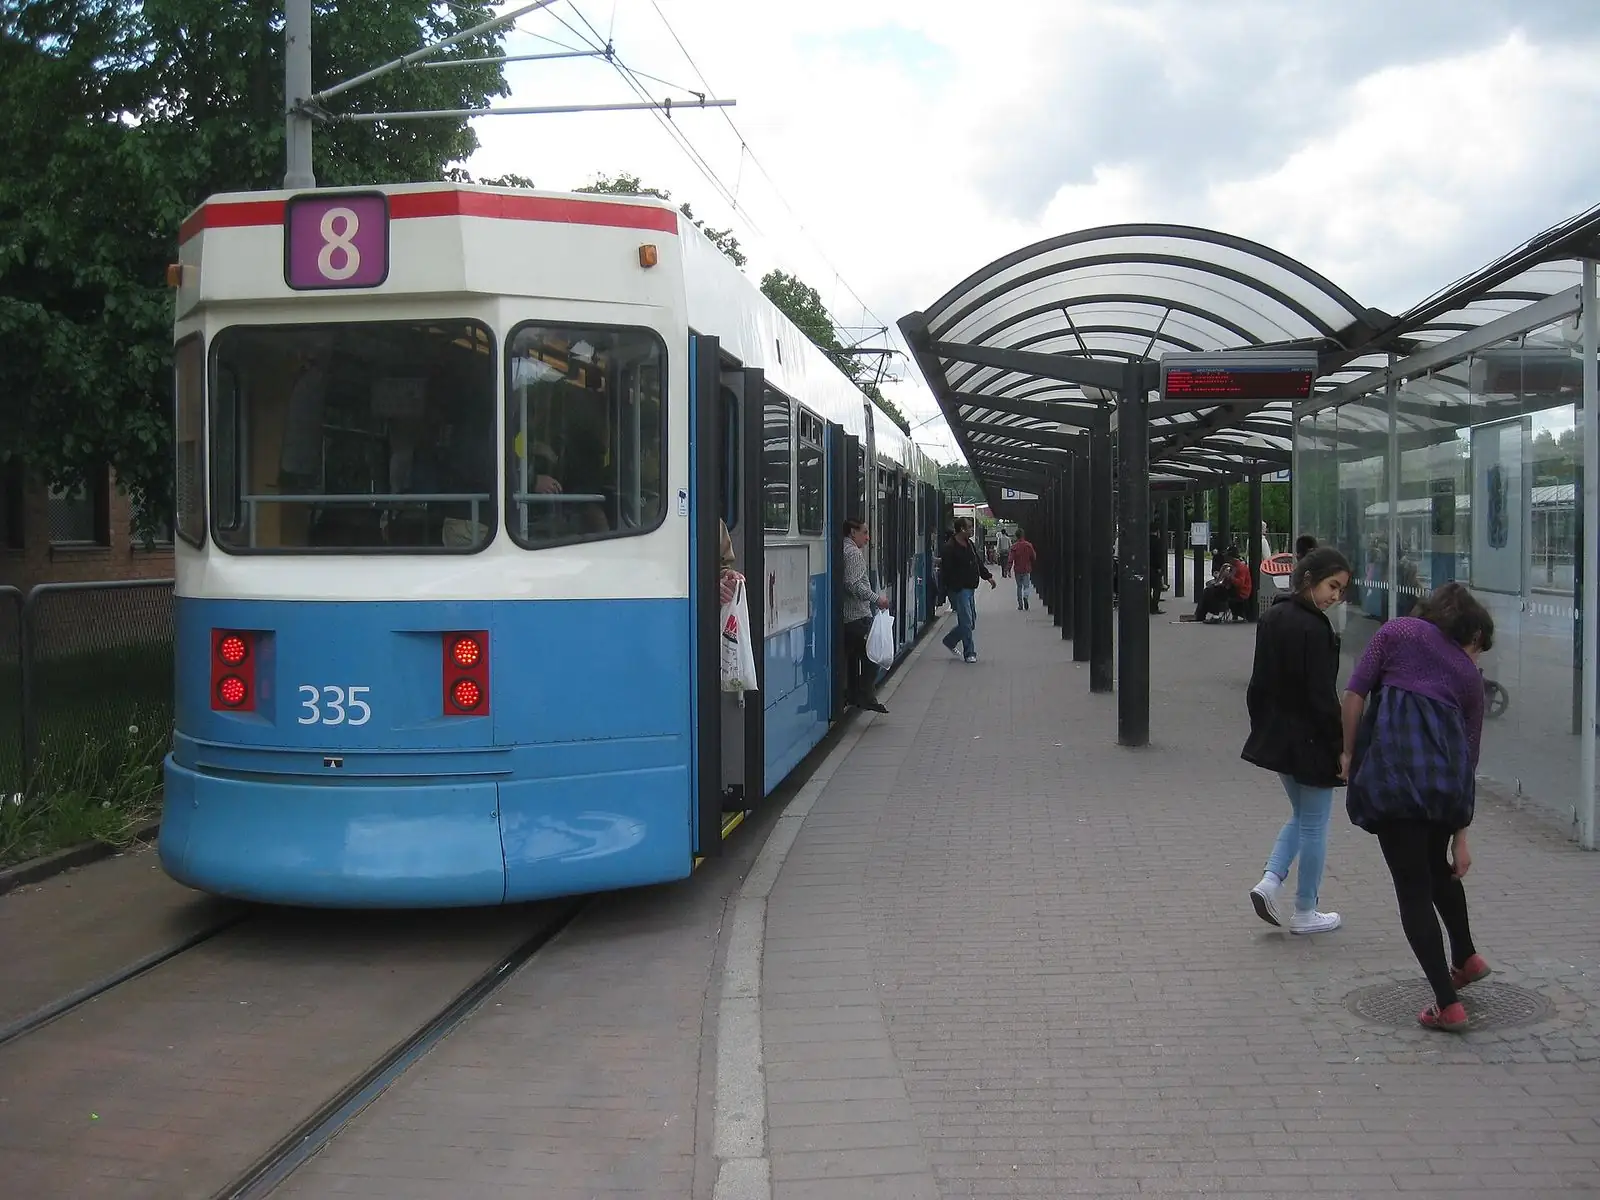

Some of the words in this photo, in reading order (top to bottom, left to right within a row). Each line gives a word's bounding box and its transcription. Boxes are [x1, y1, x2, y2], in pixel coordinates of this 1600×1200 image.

[317, 207, 361, 281] 8
[1006, 488, 1015, 498] B
[297, 685, 372, 726] 335
